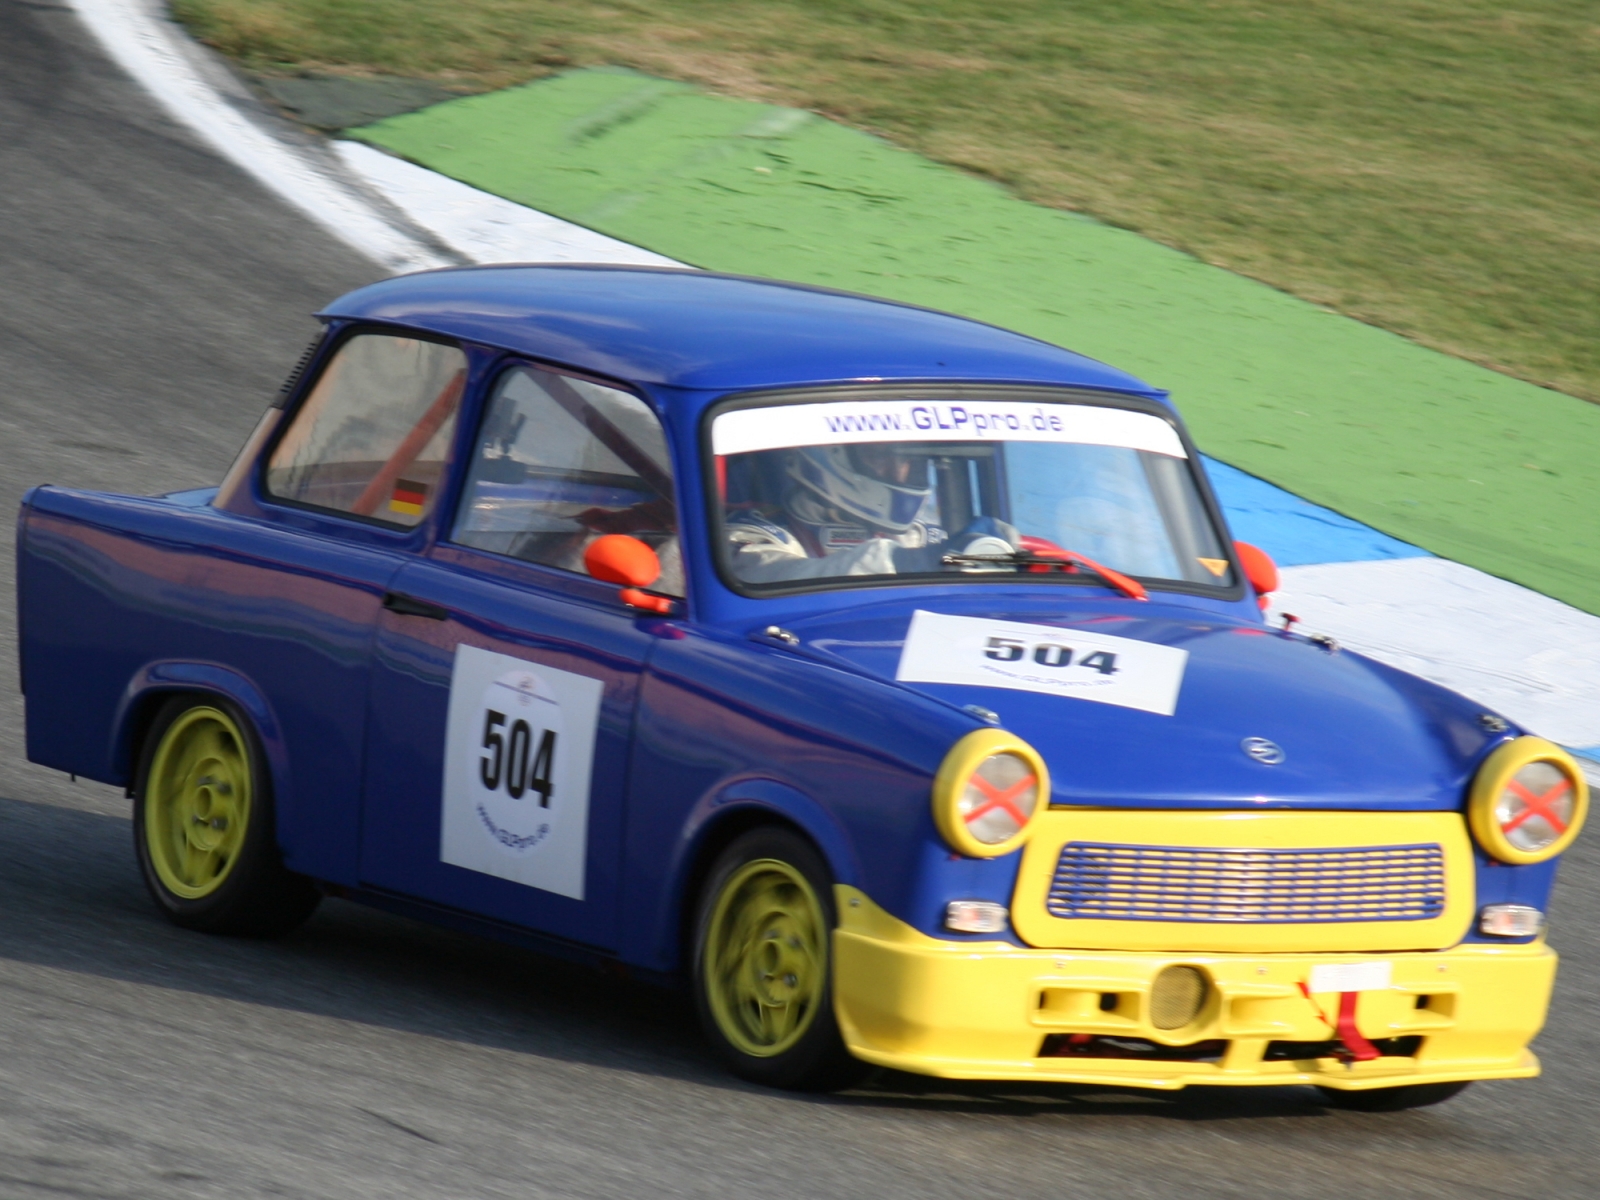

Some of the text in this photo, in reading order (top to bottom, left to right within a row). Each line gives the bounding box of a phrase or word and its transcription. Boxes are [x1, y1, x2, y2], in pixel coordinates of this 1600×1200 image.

[824, 405, 1064, 437] www.GLPpro.de
[983, 636, 1121, 676] 504
[480, 707, 558, 810] 504
